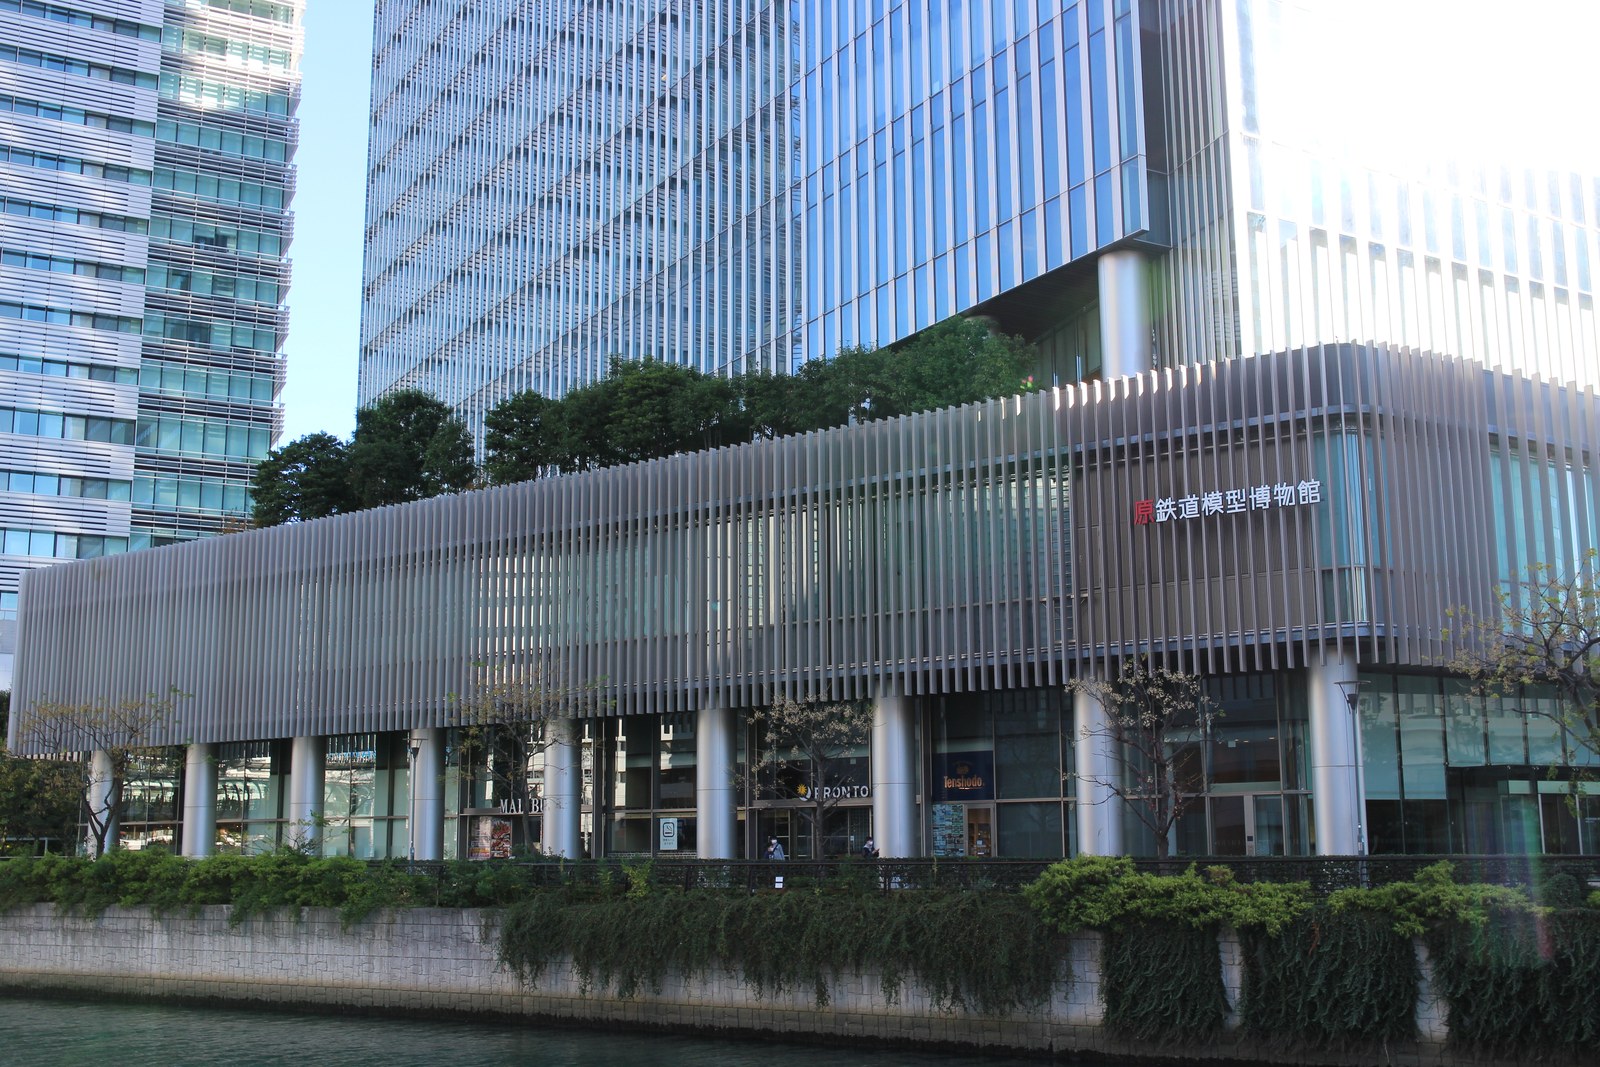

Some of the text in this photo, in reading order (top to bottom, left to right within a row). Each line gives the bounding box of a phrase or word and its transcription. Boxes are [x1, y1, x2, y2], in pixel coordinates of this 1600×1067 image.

[1134, 479, 1321, 525] 原鉄道模型博物館
[944, 774, 982, 788] Tenshodo
[500, 798, 544, 814] MALB
